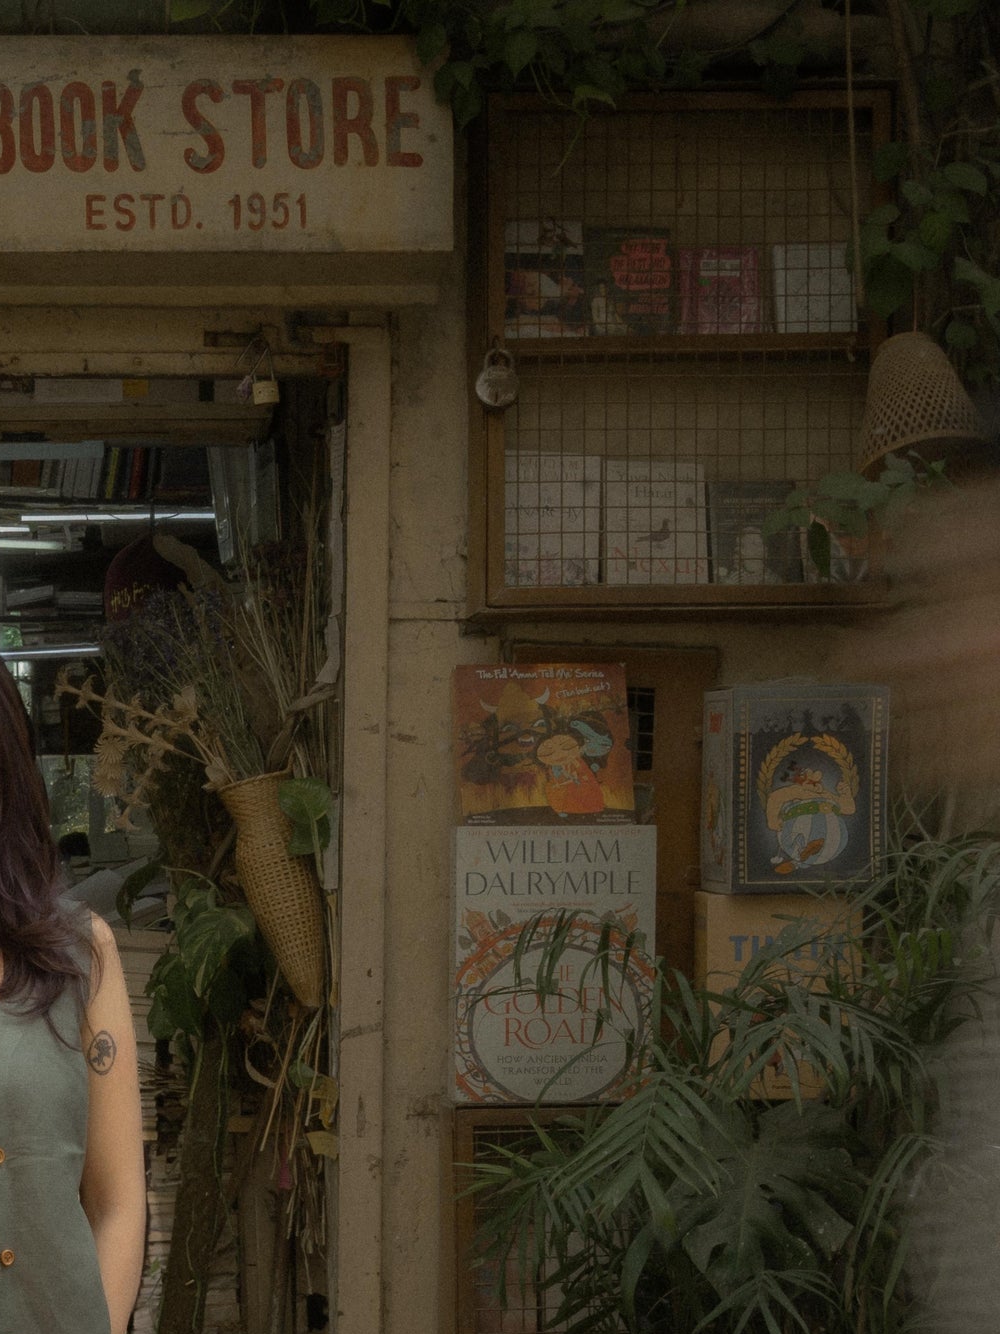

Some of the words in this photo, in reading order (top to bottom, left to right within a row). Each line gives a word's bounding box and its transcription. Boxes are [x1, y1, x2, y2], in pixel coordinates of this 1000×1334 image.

[182, 76, 424, 174] STORE
[85, 193, 204, 231] ESTD.
[228, 193, 308, 231] 1951
[635, 485, 678, 498] Harar
[609, 546, 705, 575] Nexus
[476, 669, 493, 679] The
[574, 668, 605, 679] Series
[486, 839, 621, 864] WILLIAM
[465, 871, 642, 896] DALRYMPLE
[504, 1017, 605, 1049] ROAD
[497, 1055, 522, 1064] HOW
[502, 1066, 580, 1075] TRANSFORED
[584, 1066, 604, 1075] THE
[533, 1078, 572, 1086] WOLD
